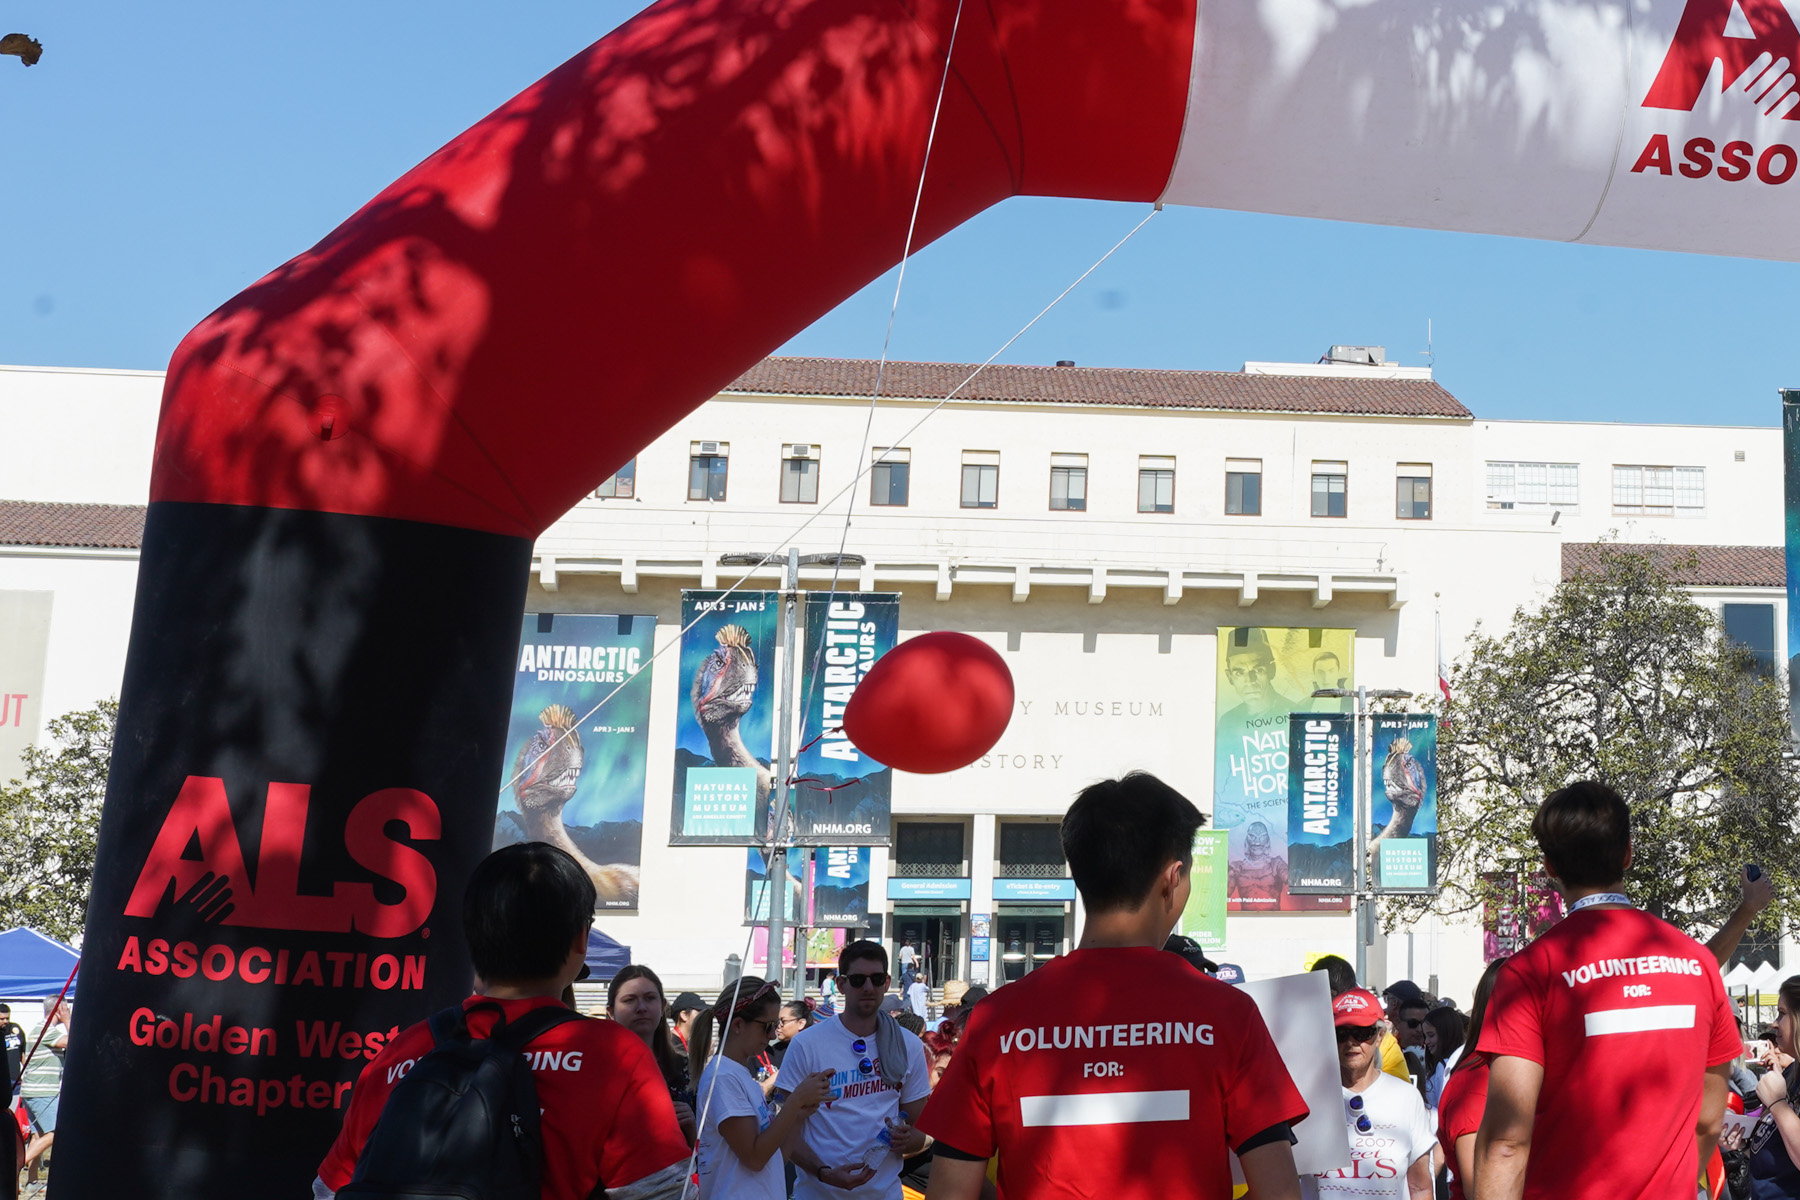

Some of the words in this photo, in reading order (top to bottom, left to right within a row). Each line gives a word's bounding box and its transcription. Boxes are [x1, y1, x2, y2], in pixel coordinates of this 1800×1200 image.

[694, 601, 718, 611] APR
[719, 602, 727, 611] 3
[735, 602, 758, 613] JAN
[758, 602, 766, 611] 5
[519, 644, 640, 675] ANTARCTIC
[538, 669, 624, 683] DINOSAURS
[820, 601, 866, 762] ANTARCTIC
[1054, 701, 1164, 717] MUSEUM
[617, 726, 630, 734] JAN
[1246, 717, 1273, 729] NOW
[1381, 721, 1396, 729] APR
[1408, 721, 1423, 730] JAN
[970, 754, 1063, 769] STORY
[1303, 719, 1332, 835] ANTARCTIC
[1327, 734, 1340, 817] DINOSAURS
[694, 783, 748, 792] NATURAL
[693, 793, 748, 801] HISTORY
[692, 804, 748, 812] MUSEUM
[1247, 802, 1261, 810] THE
[813, 823, 872, 835] NHM.ORG
[1193, 837, 1214, 846] OW
[124, 775, 442, 939] ALS
[1034, 883, 1061, 891] Re-entry
[1301, 878, 1342, 887] NHM.ORG
[823, 914, 858, 922] NHM.ORG
[1498, 879, 1514, 950] SIDER
[117, 935, 426, 990] ASSOCIATION
[1562, 955, 1702, 988] VOLUNTEERING
[1623, 984, 1652, 998] FOR:
[130, 1007, 277, 1057] Golden
[1000, 1022, 1214, 1054] VOLUNTEERING
[1083, 1061, 1125, 1078] FOR:
[831, 1070, 848, 1087] OIN
[169, 1062, 352, 1115] Chapter
[1355, 1138, 1396, 1148] 2007
[1350, 1148, 1383, 1159] eet
